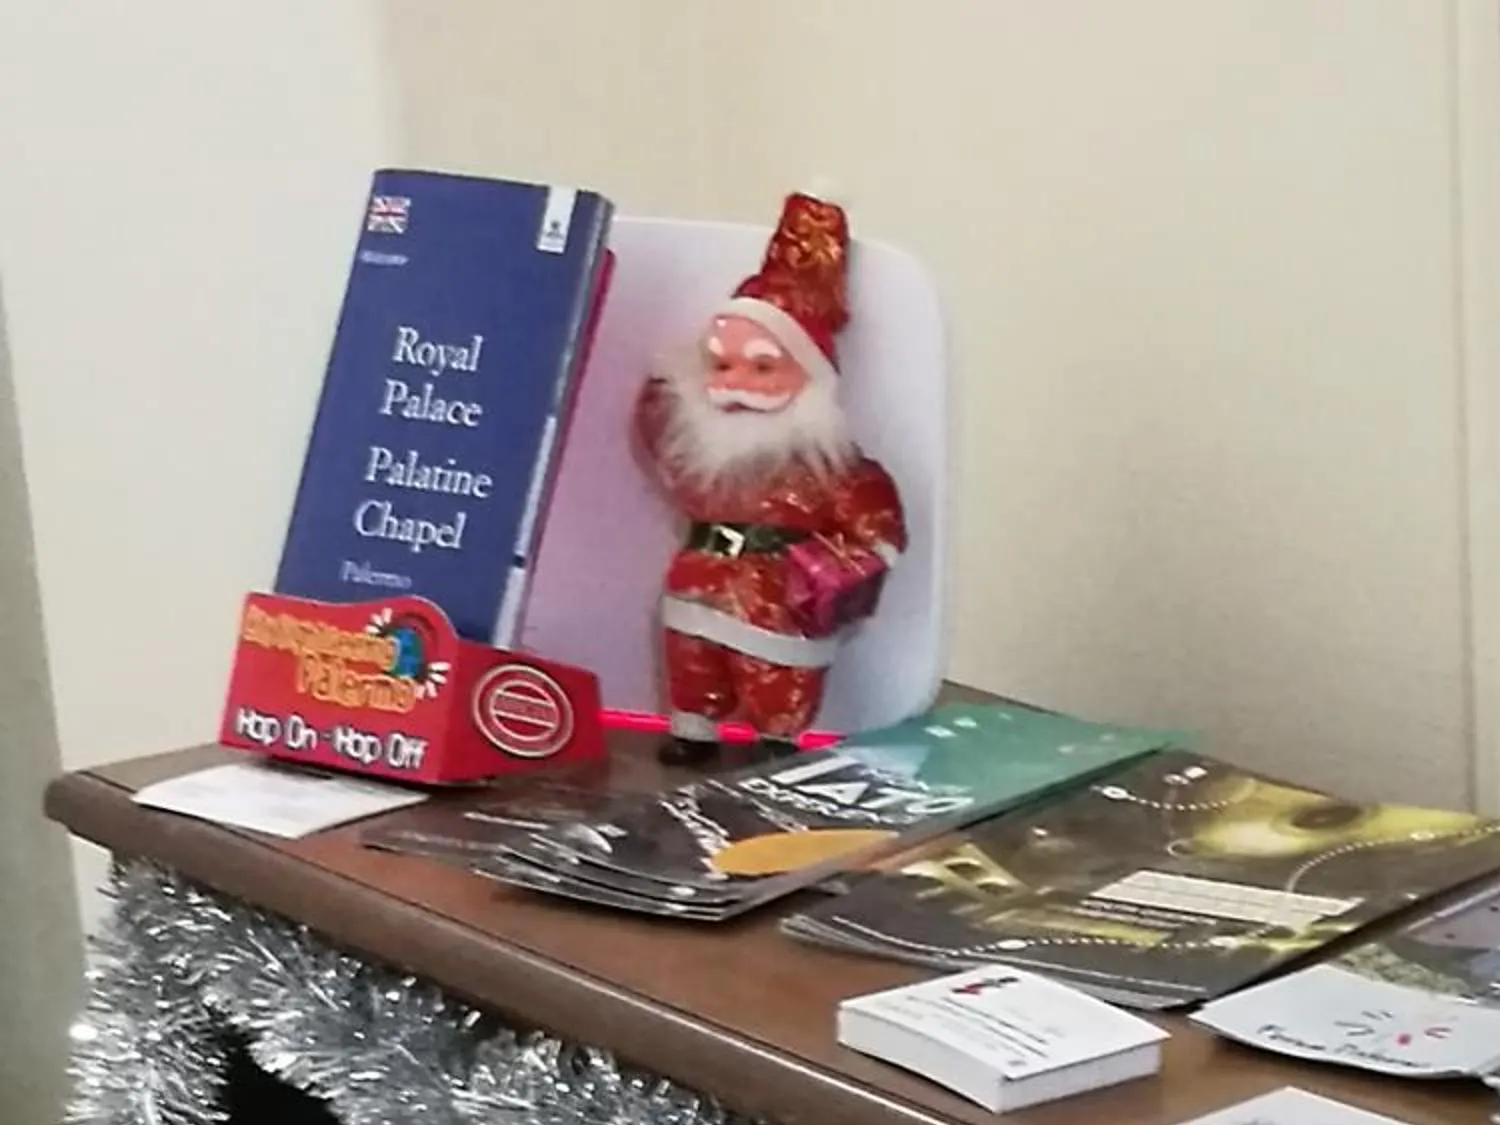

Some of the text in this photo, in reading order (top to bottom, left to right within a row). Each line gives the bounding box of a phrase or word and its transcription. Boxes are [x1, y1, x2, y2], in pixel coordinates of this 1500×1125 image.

[393, 326, 483, 375] Royal
[378, 378, 483, 427] Palace
[365, 446, 493, 498] Palatine
[353, 499, 468, 553] Chapel
[236, 706, 281, 745] Hop
[285, 714, 318, 749] On
[333, 725, 382, 764] Hop
[388, 733, 429, 768] Off
